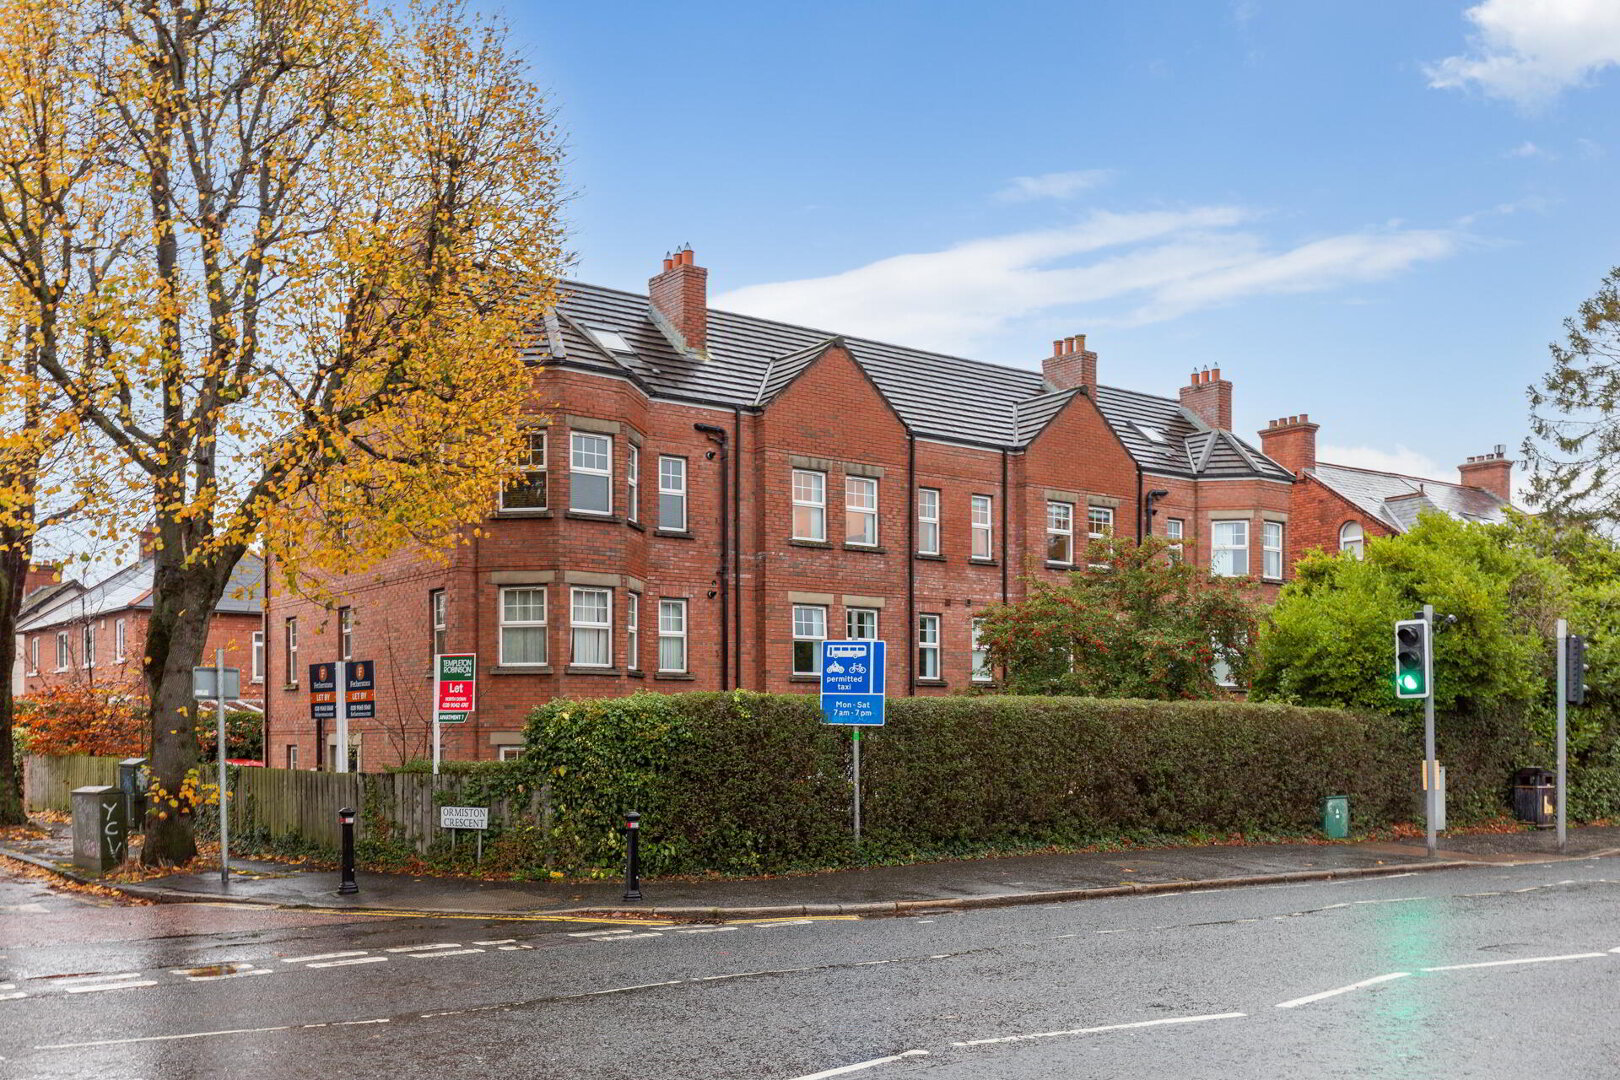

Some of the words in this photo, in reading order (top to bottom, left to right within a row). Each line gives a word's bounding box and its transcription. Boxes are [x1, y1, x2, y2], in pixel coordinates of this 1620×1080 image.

[449, 683, 464, 693] Let
[443, 808, 485, 817] ORMISTON
[444, 818, 484, 827] CRESCENT
